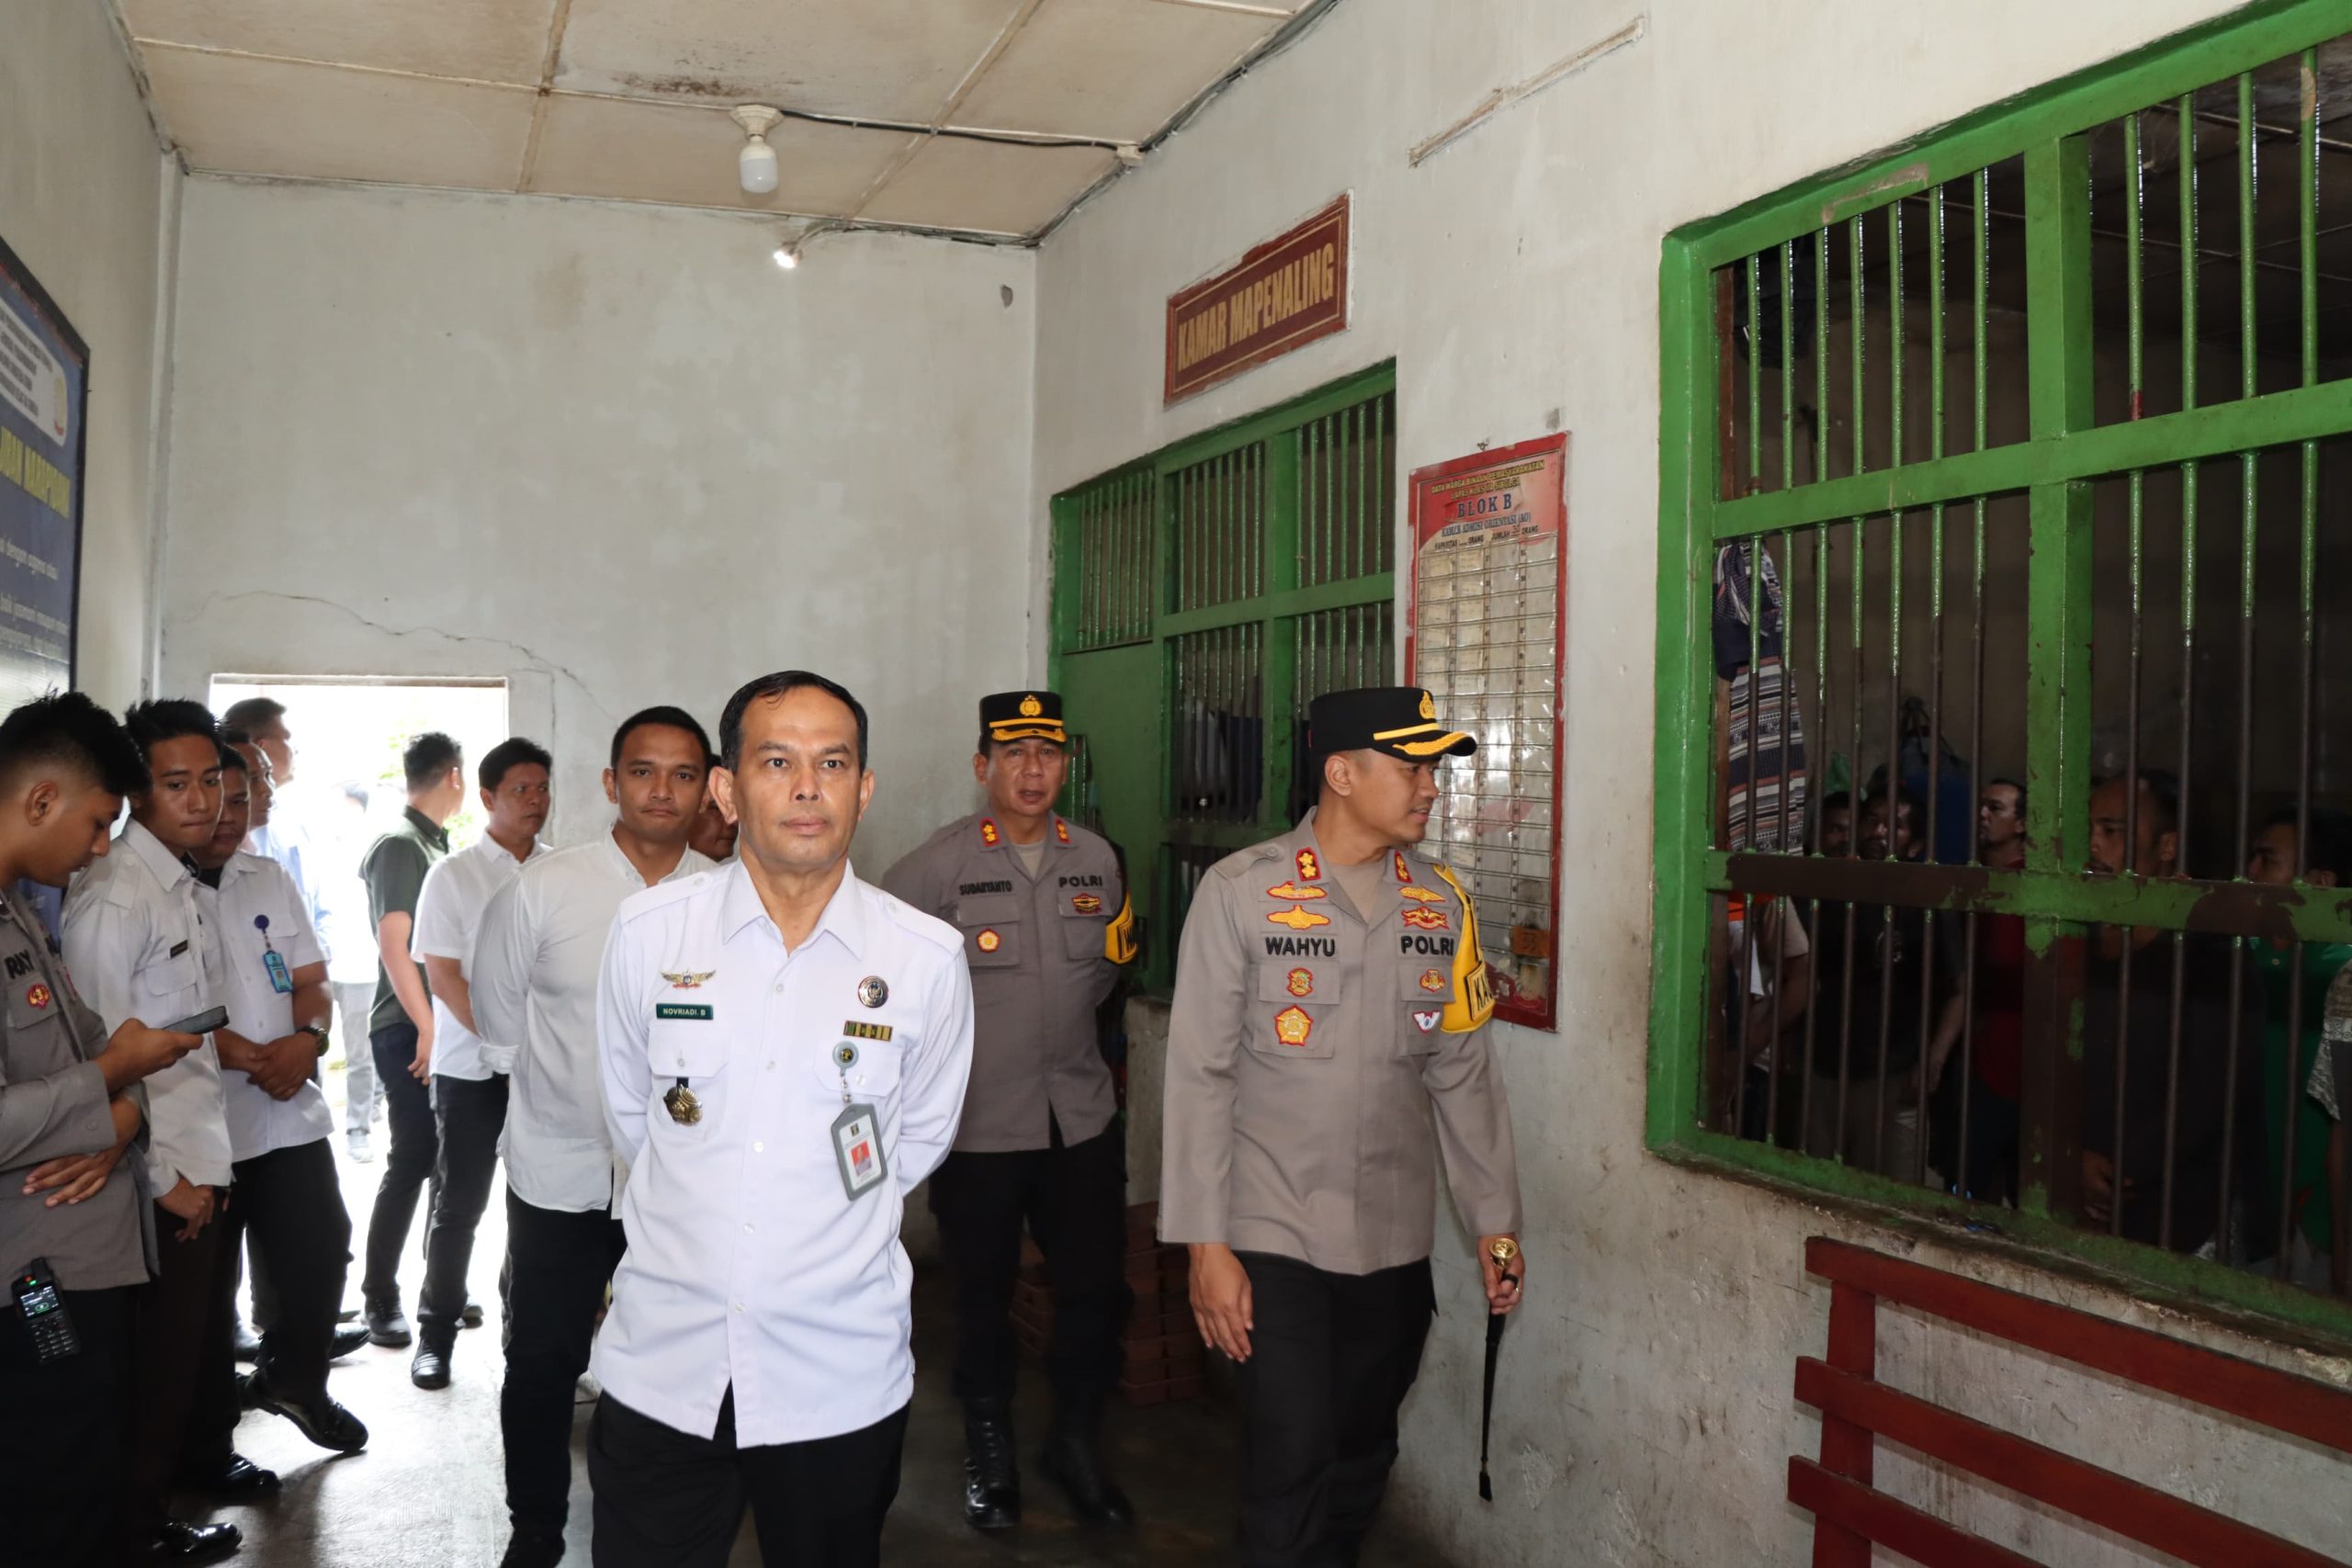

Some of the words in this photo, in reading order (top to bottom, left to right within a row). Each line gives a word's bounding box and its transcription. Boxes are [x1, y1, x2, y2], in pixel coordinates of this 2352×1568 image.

[1178, 301, 1227, 372] KAMAR
[1229, 243, 1335, 345] MAPENALING
[1457, 495, 1498, 518] BLOK
[1503, 493, 1512, 510] B
[1058, 874, 1102, 888] POLRI
[1265, 936, 1336, 957] WAHYU
[1400, 935, 1454, 956] POLRI
